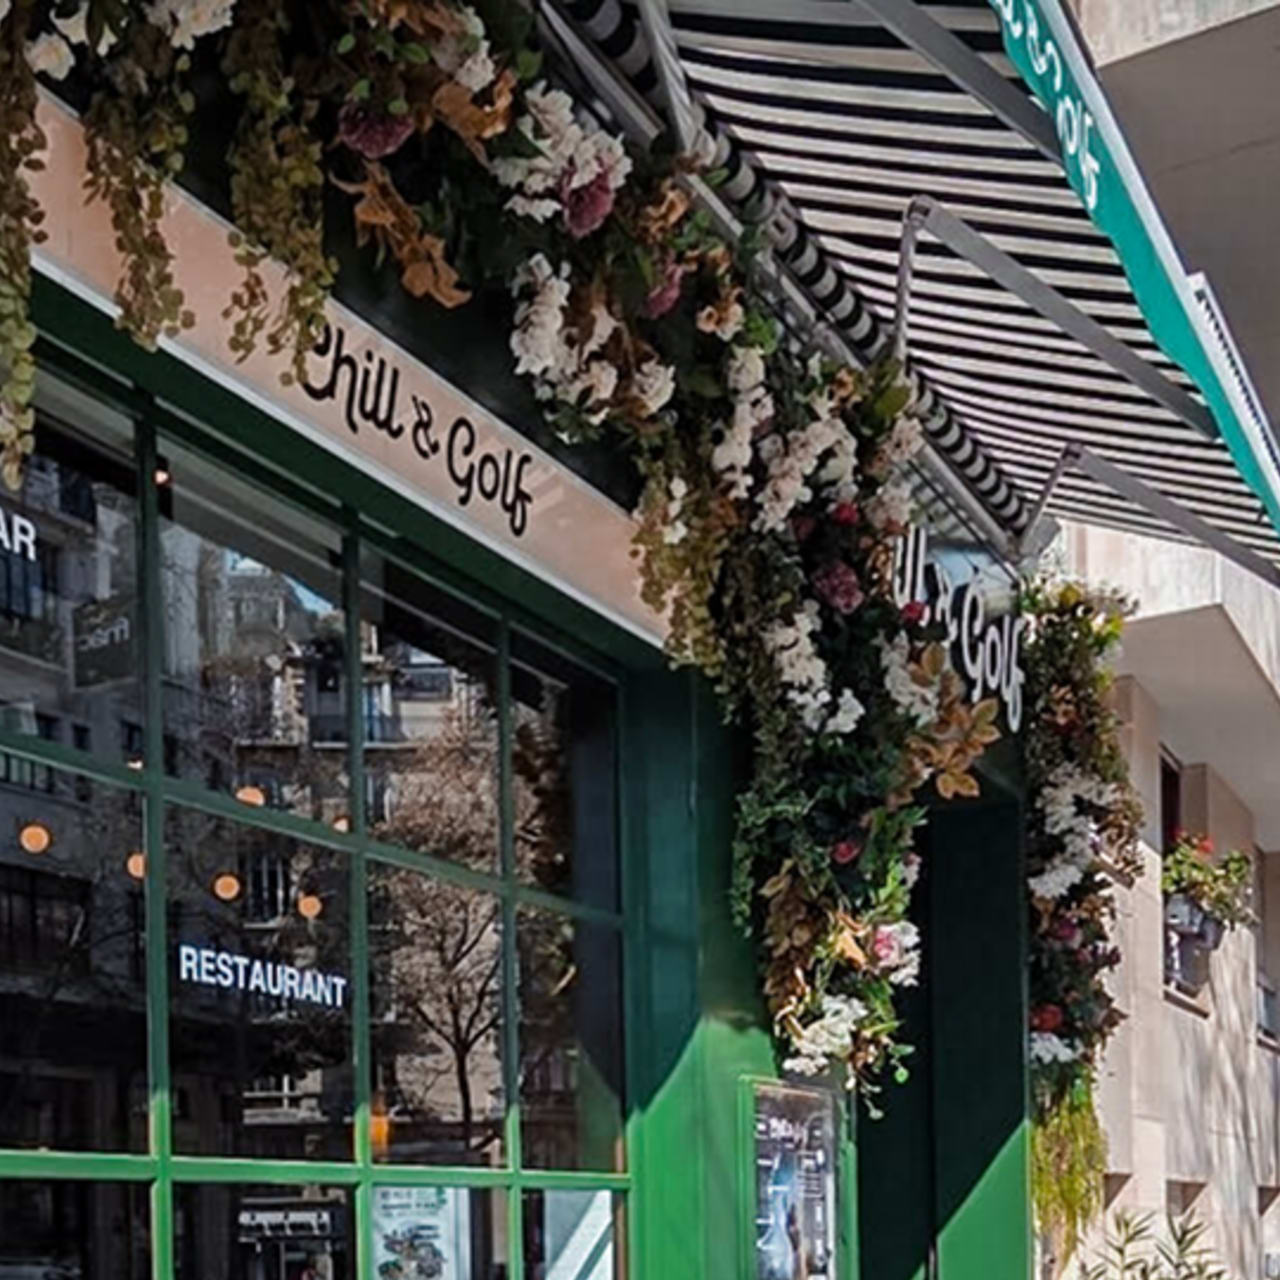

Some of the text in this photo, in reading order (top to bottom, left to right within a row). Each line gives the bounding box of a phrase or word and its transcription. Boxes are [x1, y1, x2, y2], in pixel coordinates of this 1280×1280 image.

[304, 323, 533, 537] Chill & Golf
[962, 575, 1025, 733] Golf
[180, 945, 347, 1008] RESTAURANT
